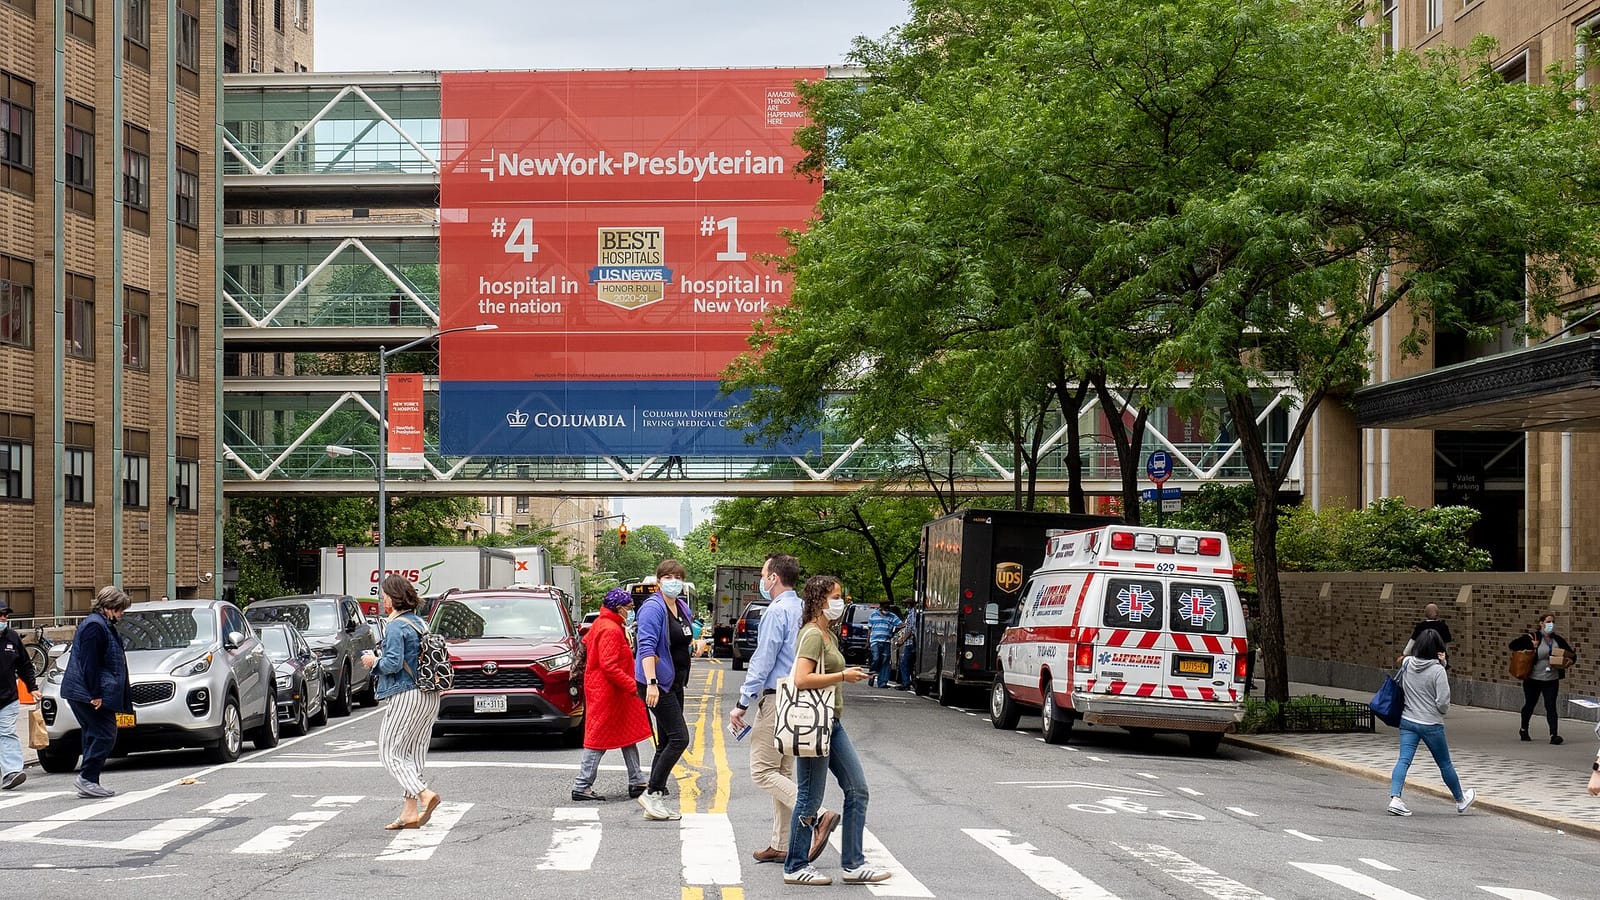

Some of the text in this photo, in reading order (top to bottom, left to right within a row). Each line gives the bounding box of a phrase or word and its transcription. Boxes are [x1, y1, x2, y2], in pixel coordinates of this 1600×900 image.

[498, 150, 784, 182] NewYork-Presbyterian
[491, 217, 539, 263] #4
[602, 231, 660, 250] BEST
[700, 216, 747, 262] #1
[602, 251, 660, 264] HOSPITALS
[480, 276, 578, 299] hospital in
[602, 284, 658, 293] HONOR ROLL
[681, 275, 783, 298] hospital in
[479, 299, 561, 314] the nation
[694, 297, 769, 313] New York
[534, 412, 627, 428] COLUMBIA
[642, 410, 688, 418] COLUMBIA
[642, 419, 674, 427] IRVING
[677, 419, 716, 427] MEDICAL
[1456, 474, 1475, 482] Valet
[1452, 483, 1480, 492] Parking
[514, 560, 529, 571] X
[1156, 562, 1175, 573] 629
[728, 578, 760, 592] freshdi
[998, 570, 1021, 589] ups
[1130, 593, 1143, 611] L
[1192, 597, 1205, 615] L
[1111, 652, 1162, 665] LIFELINE
